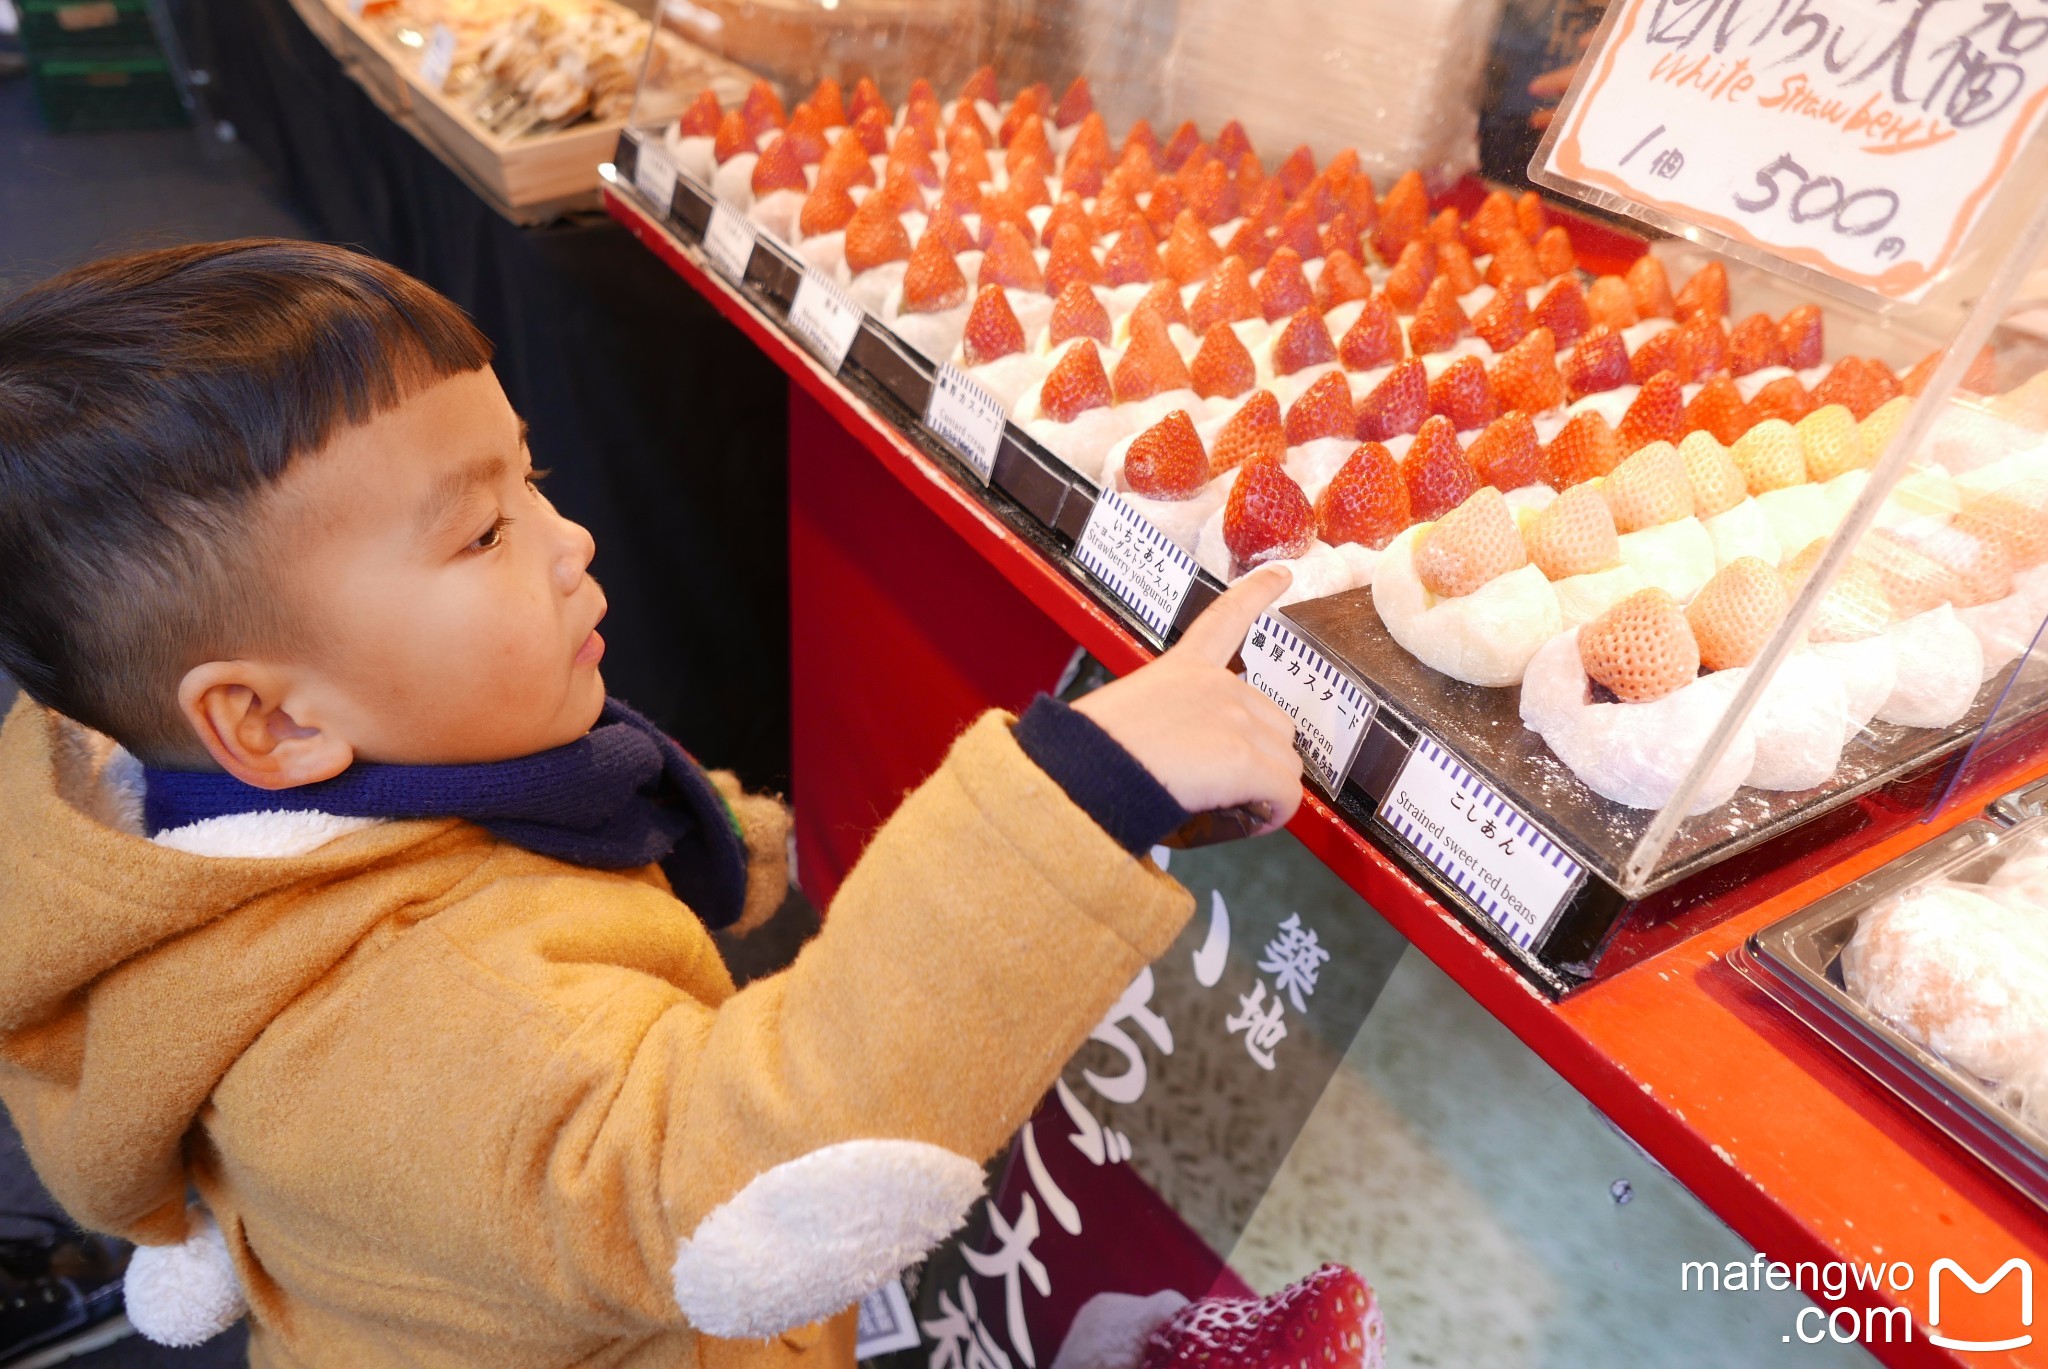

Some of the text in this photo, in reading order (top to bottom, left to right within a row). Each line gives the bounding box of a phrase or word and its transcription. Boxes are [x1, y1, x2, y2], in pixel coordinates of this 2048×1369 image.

[1649, 51, 1755, 102] White
[1087, 528, 1172, 614] Strawberry yohguruto
[1113, 518, 1165, 573] いちごあん
[1251, 629, 1359, 730] 濃厚カスタード
[1252, 672, 1334, 755] Custard cream
[1396, 790, 1537, 926] Strained sweet red beans
[1450, 790, 1516, 856] こしあん
[1226, 912, 1329, 1070] 築地
